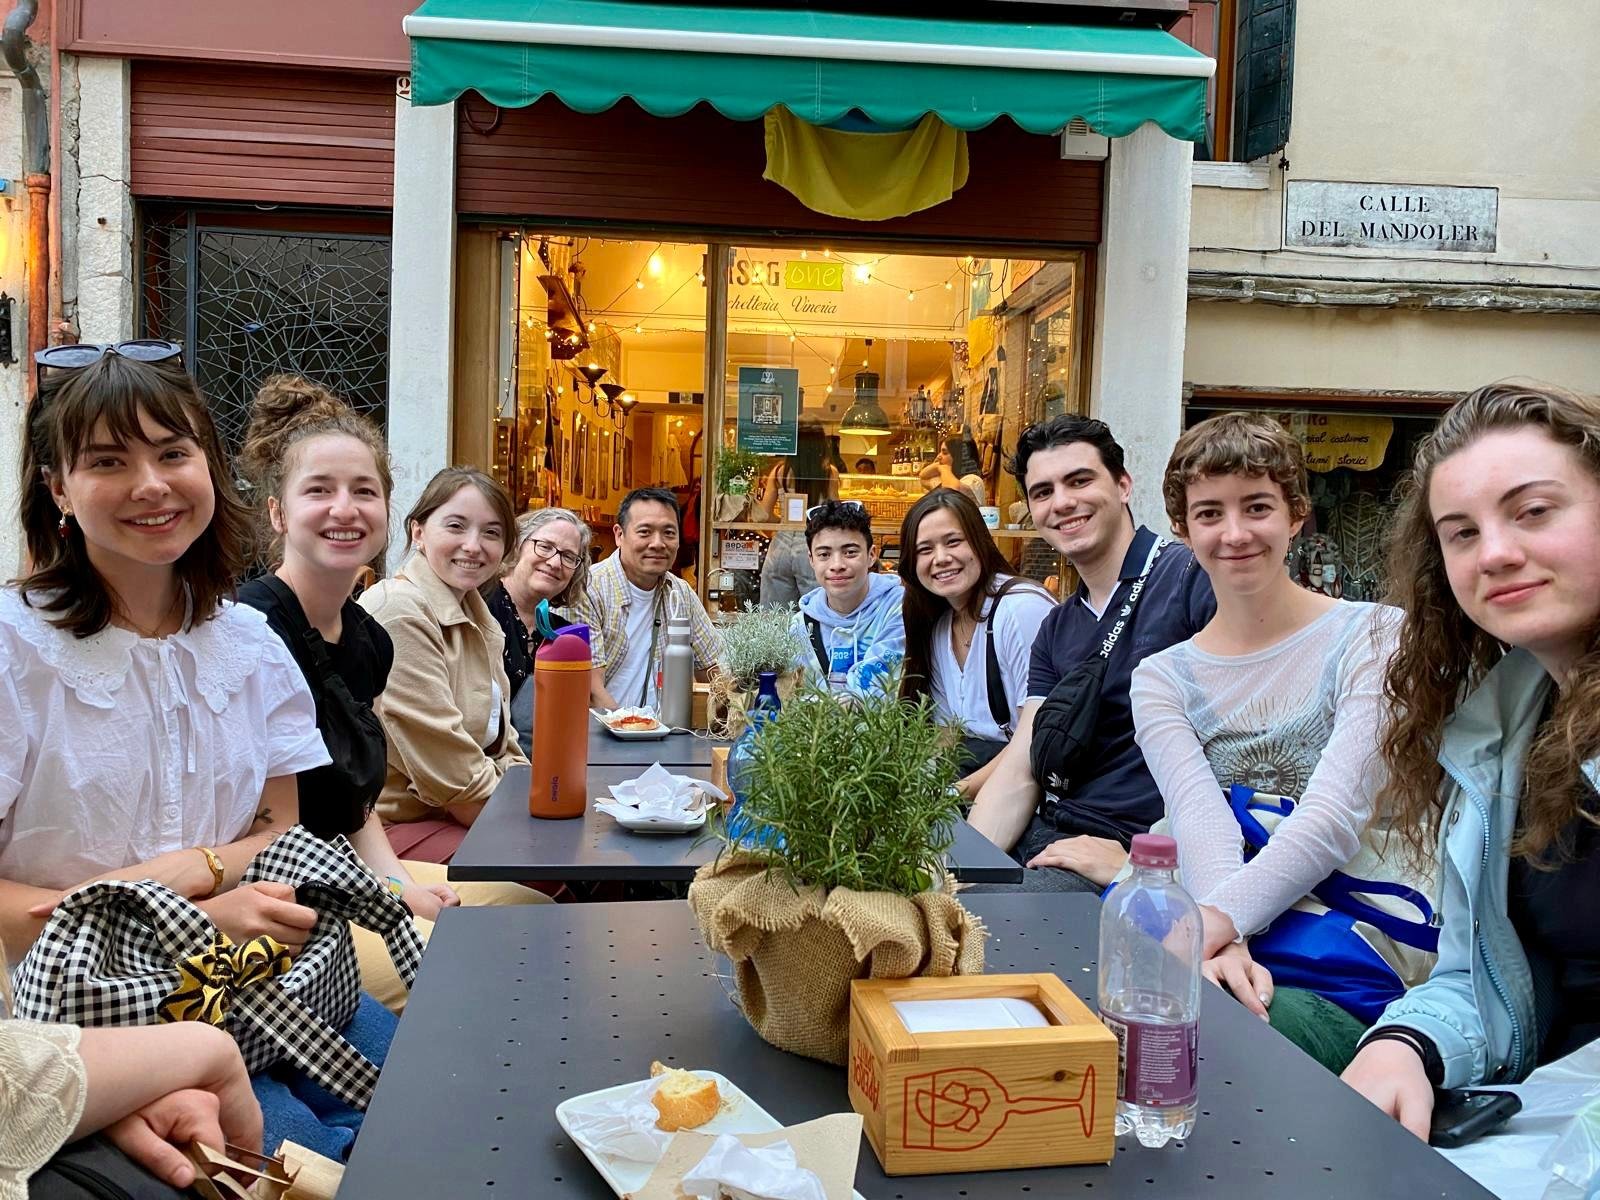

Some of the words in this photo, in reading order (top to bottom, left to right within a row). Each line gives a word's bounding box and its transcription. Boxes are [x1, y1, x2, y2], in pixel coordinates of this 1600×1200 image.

[1360, 195, 1430, 213] CALLE
[1301, 220, 1345, 237] DEL
[1360, 222, 1478, 241] MANDOLER
[791, 264, 836, 286] one
[791, 296, 837, 314] Vineria
[1330, 432, 1369, 443] costumes
[1337, 453, 1368, 464] storici
